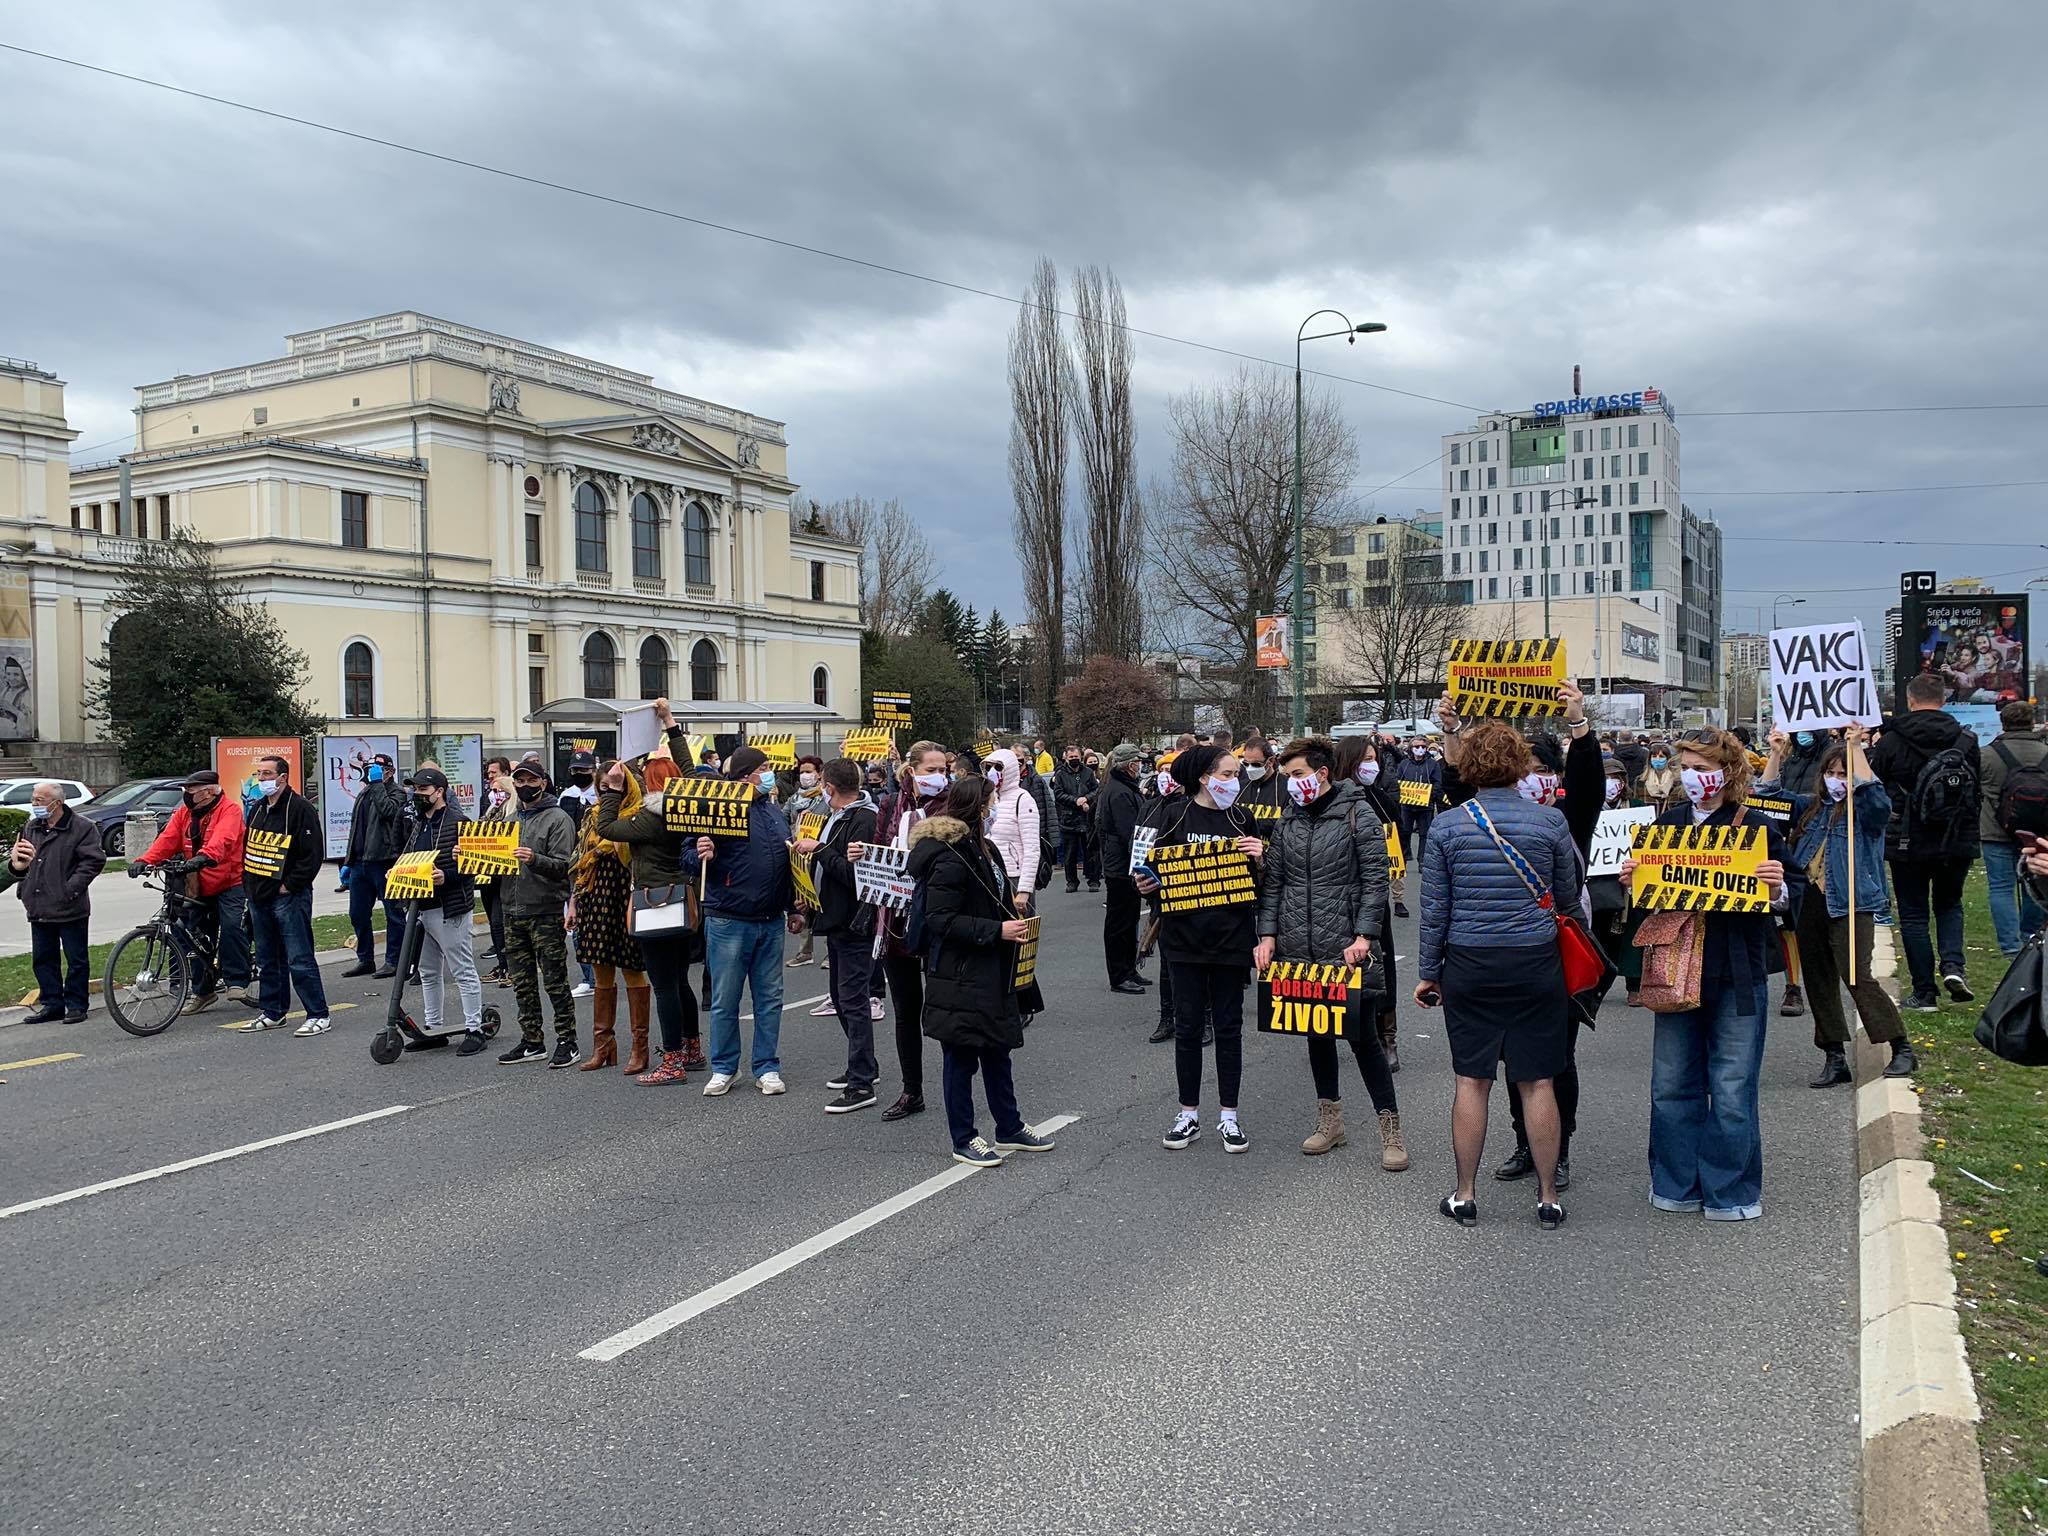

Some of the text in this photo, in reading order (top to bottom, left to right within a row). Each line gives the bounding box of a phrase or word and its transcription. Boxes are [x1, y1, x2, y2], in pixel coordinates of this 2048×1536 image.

[1534, 391, 1643, 417] SPARKASSE
[1927, 606, 1981, 618] Sreća je veća
[1927, 618, 1948, 627] kada
[1452, 665, 1553, 678] BUDITE NAM PRIMJER
[1458, 675, 1497, 695] DAJTE
[226, 747, 253, 756] KURSEVI
[665, 798, 749, 818] PCR TEST
[665, 813, 748, 829] OBAVEZAN ZA SVE
[1157, 862, 1194, 874] GLASOM,
[1194, 857, 1217, 869] KOGA
[1640, 853, 1732, 867] IGRATE SE DRŽAVE?
[1161, 876, 1168, 887] U
[1169, 872, 1196, 885] ZEMLJI
[1196, 869, 1217, 882] KOJU
[1661, 863, 1760, 895] GAME OVER
[890, 884, 903, 894] WAS
[1160, 889, 1167, 900] O
[1167, 884, 1202, 899] VAKCINI
[1202, 881, 1223, 894] KOJU
[1161, 890, 1257, 913] JA PJEVAM PJESMU, MAJKO.
[1271, 978, 1347, 1001] BORBA ZA
[1270, 995, 1347, 1036] ŽIVOT
